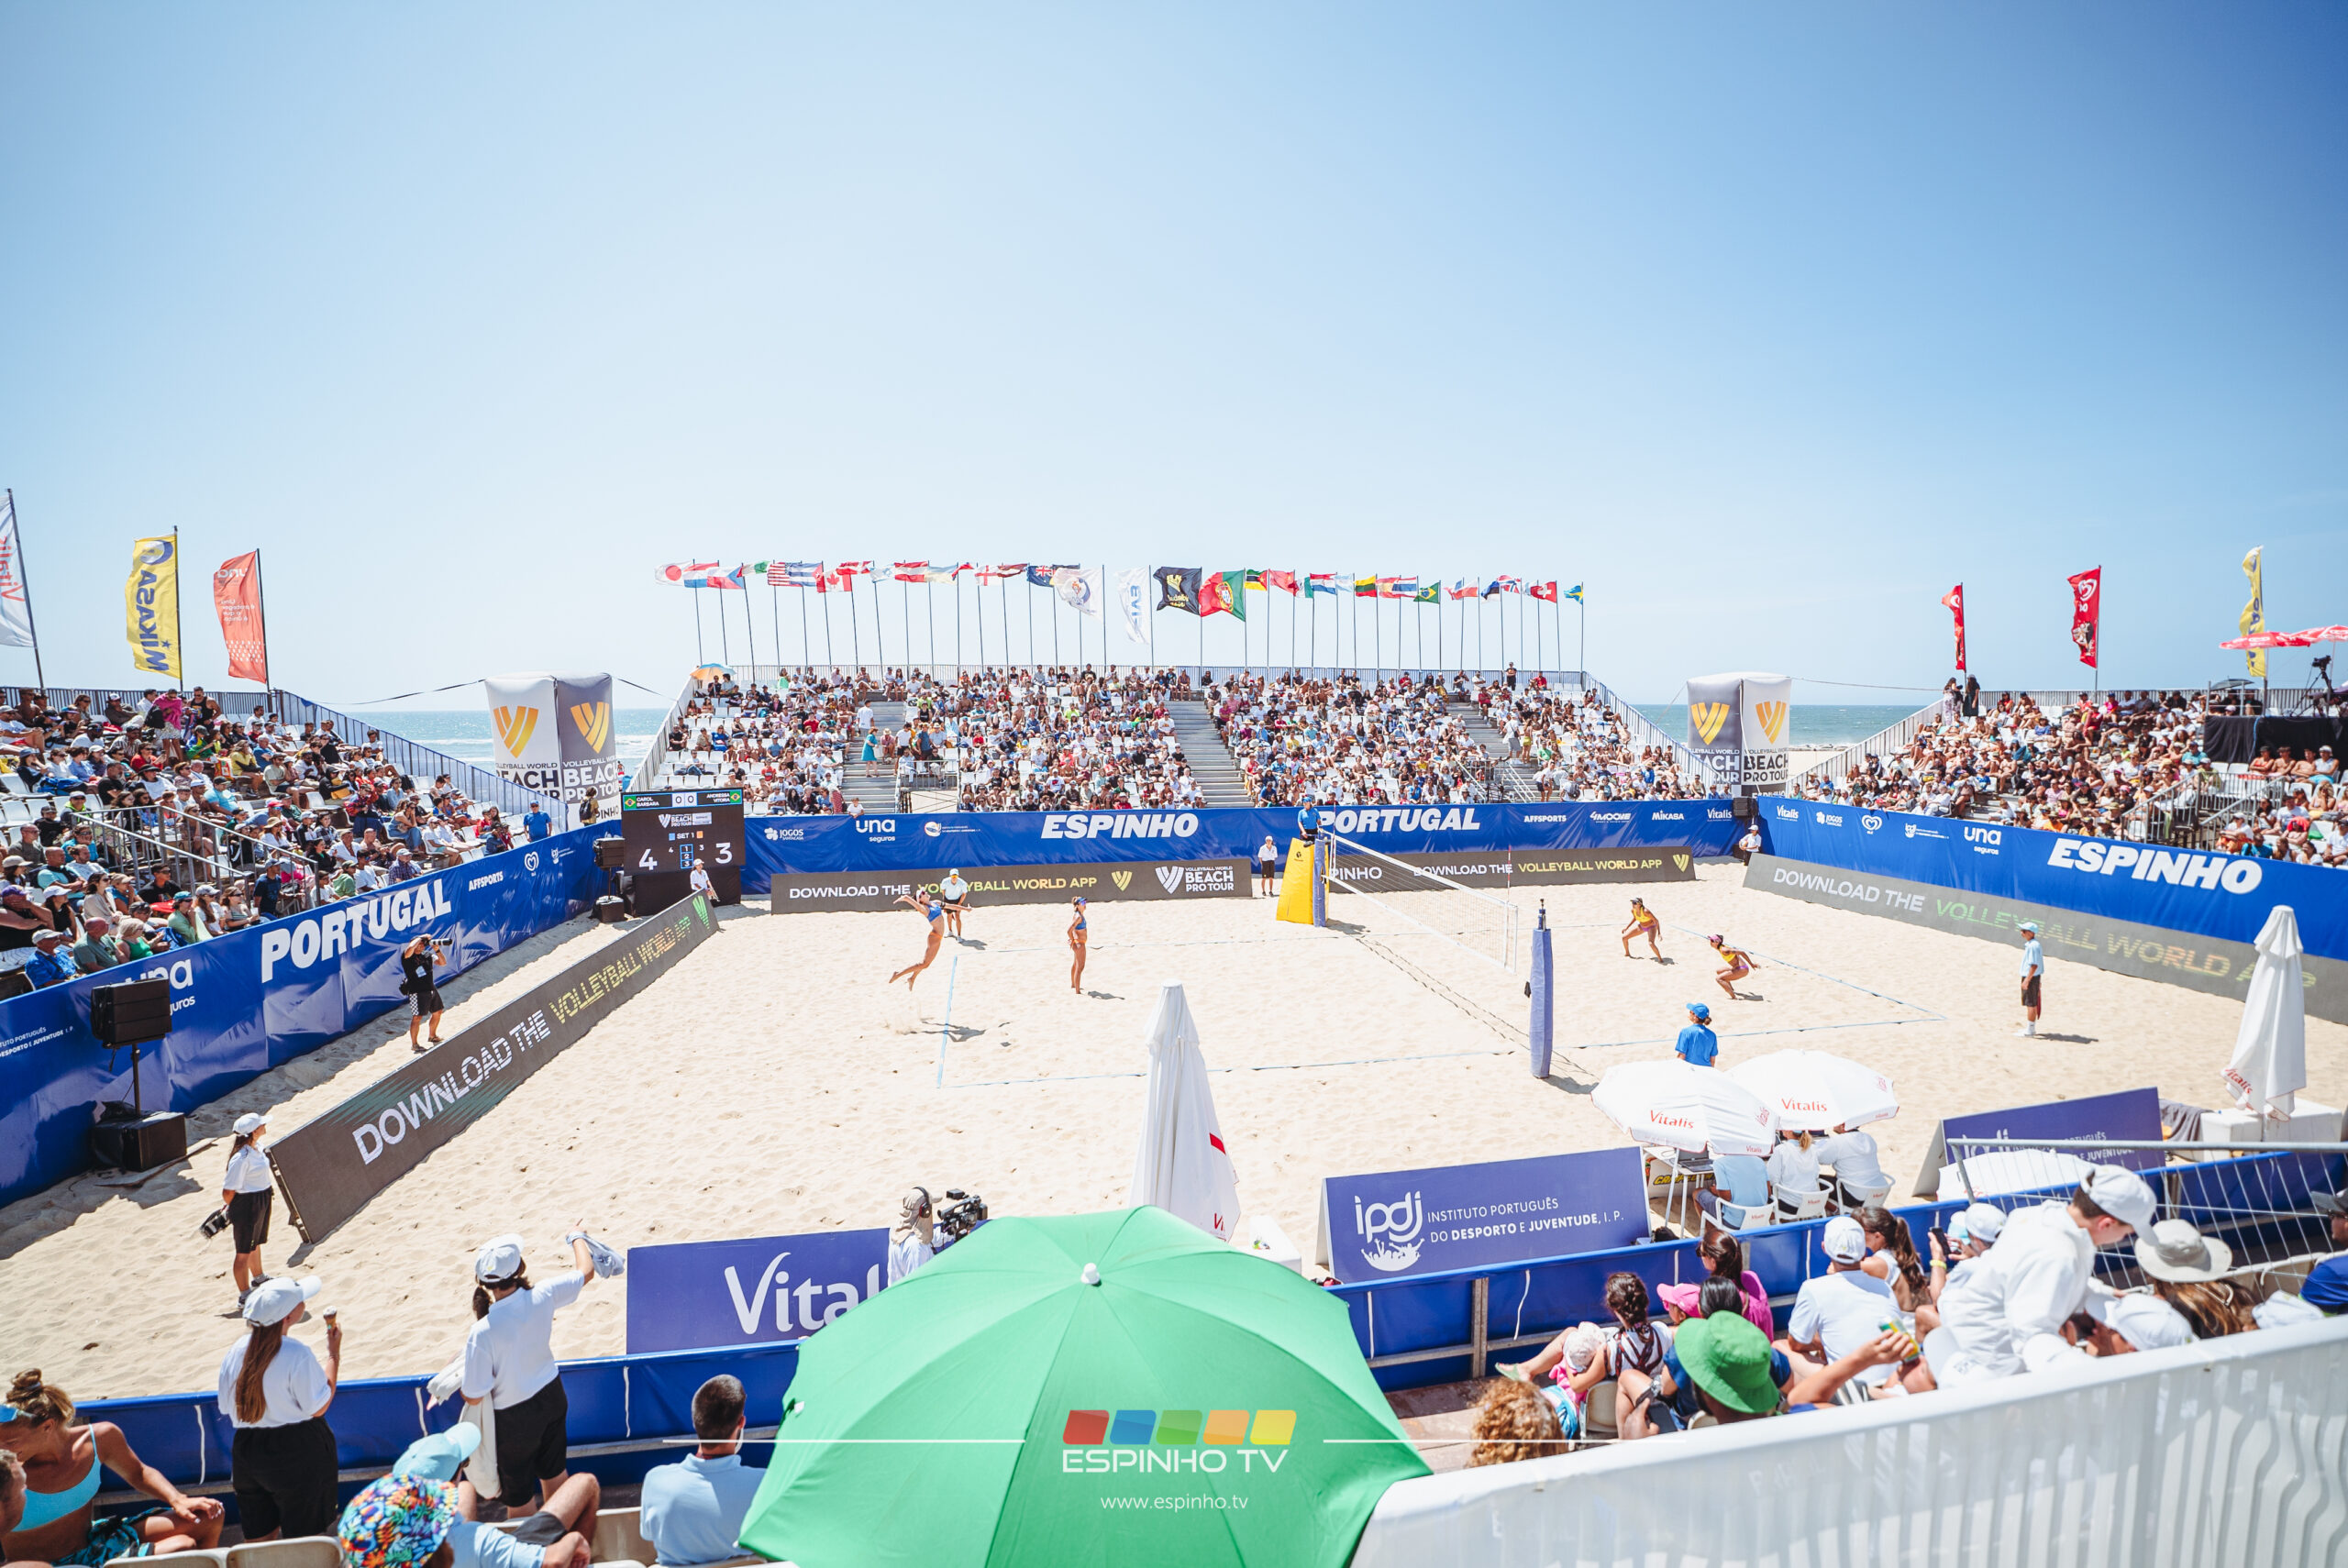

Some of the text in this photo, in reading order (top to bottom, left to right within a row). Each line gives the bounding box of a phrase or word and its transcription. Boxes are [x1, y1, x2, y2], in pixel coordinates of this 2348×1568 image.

[675, 794, 694, 804] 0 0
[1318, 808, 1480, 834] PORTUGAL
[1523, 814, 1567, 823] AFFSPORTS
[1707, 807, 1733, 819] Vitalis
[1777, 805, 1800, 819] Vitalis
[780, 829, 804, 838] JOGOS
[856, 819, 896, 834] una
[1041, 812, 1199, 839] ESPINHO
[869, 835, 896, 844] seguros
[1964, 826, 2001, 845] una
[638, 848, 659, 870] 4
[715, 842, 733, 864] 3
[1974, 845, 1999, 856] seguros
[1489, 864, 1512, 875] THE
[1518, 860, 1591, 873] VOLLEYBALL
[1595, 859, 1639, 871] WORLD
[1641, 859, 1663, 870] APP
[2047, 838, 2263, 895] ESPINHO
[469, 870, 504, 892] AFFSPORTS
[1185, 870, 1235, 884] BEACH
[1186, 882, 1235, 891] PRO TOUR
[789, 886, 879, 899] DOWNLOAD
[881, 884, 911, 895] THE
[1013, 878, 1067, 890] WORLD
[1069, 877, 1098, 889] APP
[261, 878, 452, 984] PORTUGAL
[1774, 867, 1881, 903] DOWNLOAD
[1885, 889, 1926, 912] THE
[2108, 933, 2232, 978] WORLD
[15, 1026, 47, 1043] PORTUGUÊS
[352, 1036, 514, 1165] DOWNLOAD
[508, 1009, 550, 1053] THE
[548, 952, 642, 1024] VOLLEYBALL
[639, 927, 676, 967] WORLD
[1781, 1098, 1828, 1112] Vitalis
[1650, 1110, 1695, 1129] Vitalis
[1745, 1145, 1763, 1154] Vitalis
[1427, 1197, 1559, 1224] INSTITUTO PORTUGUÊS
[1430, 1231, 1448, 1243] DO
[1451, 1222, 1517, 1241] DESPORTO
[1520, 1222, 1526, 1233] E
[1529, 1212, 1601, 1232] JUVENTUDE,
[725, 1252, 880, 1335] Vital
